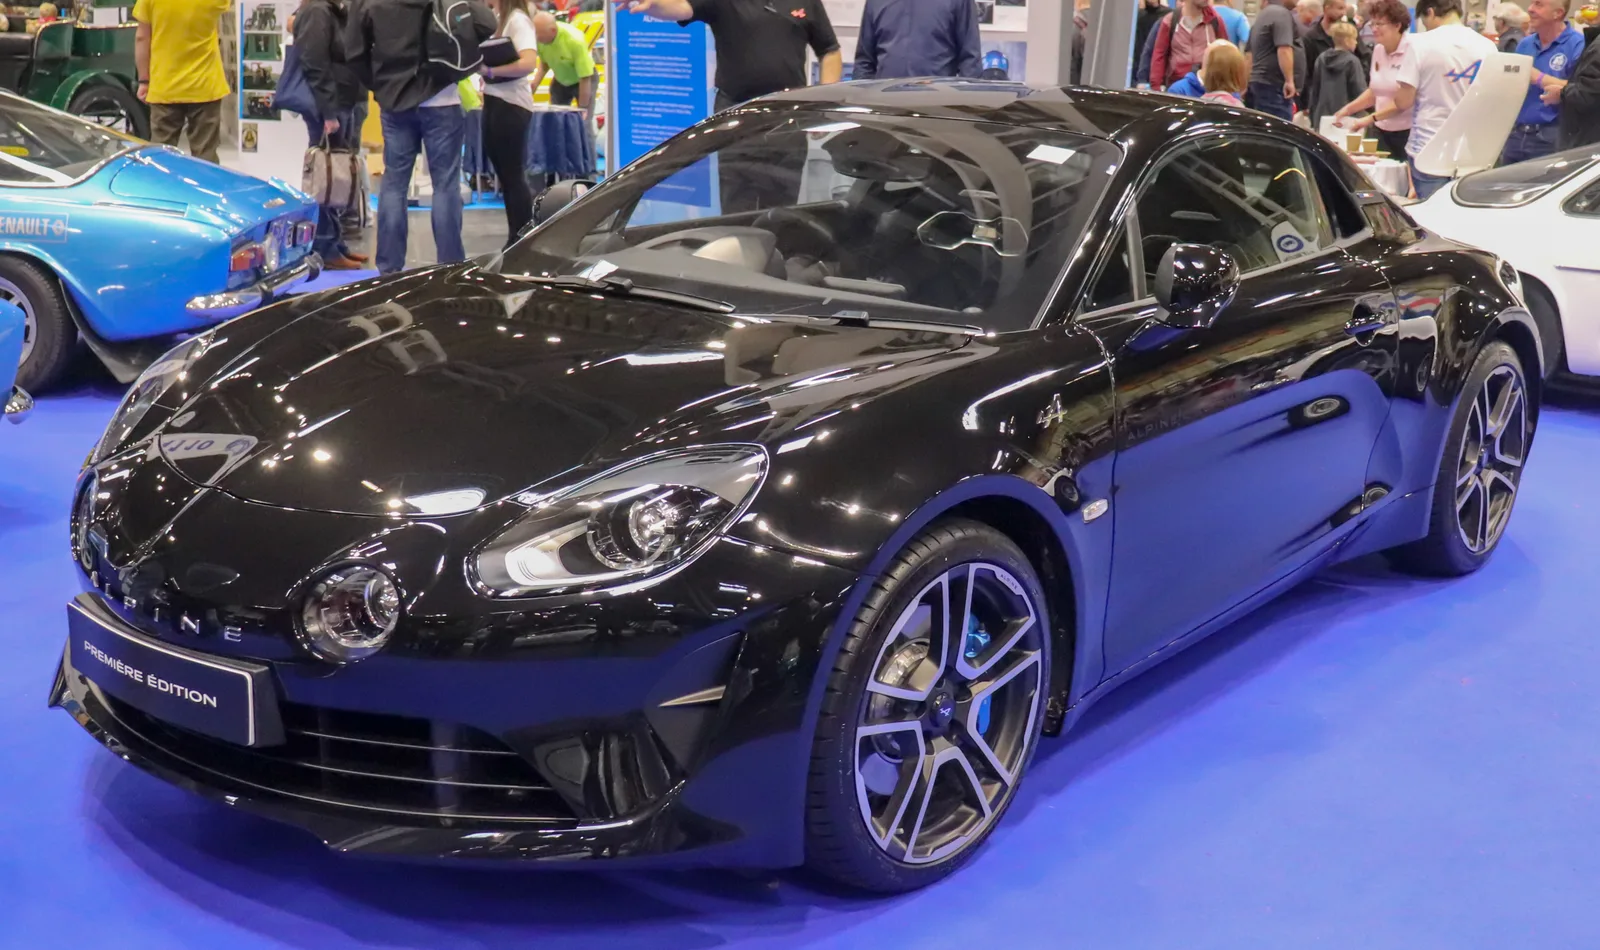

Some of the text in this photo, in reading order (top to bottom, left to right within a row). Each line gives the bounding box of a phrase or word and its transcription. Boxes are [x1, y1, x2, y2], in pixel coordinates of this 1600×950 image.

[1128, 415, 1180, 441] ALPINE
[90, 570, 242, 642] ALPINE
[147, 673, 217, 708] ÉDITION
